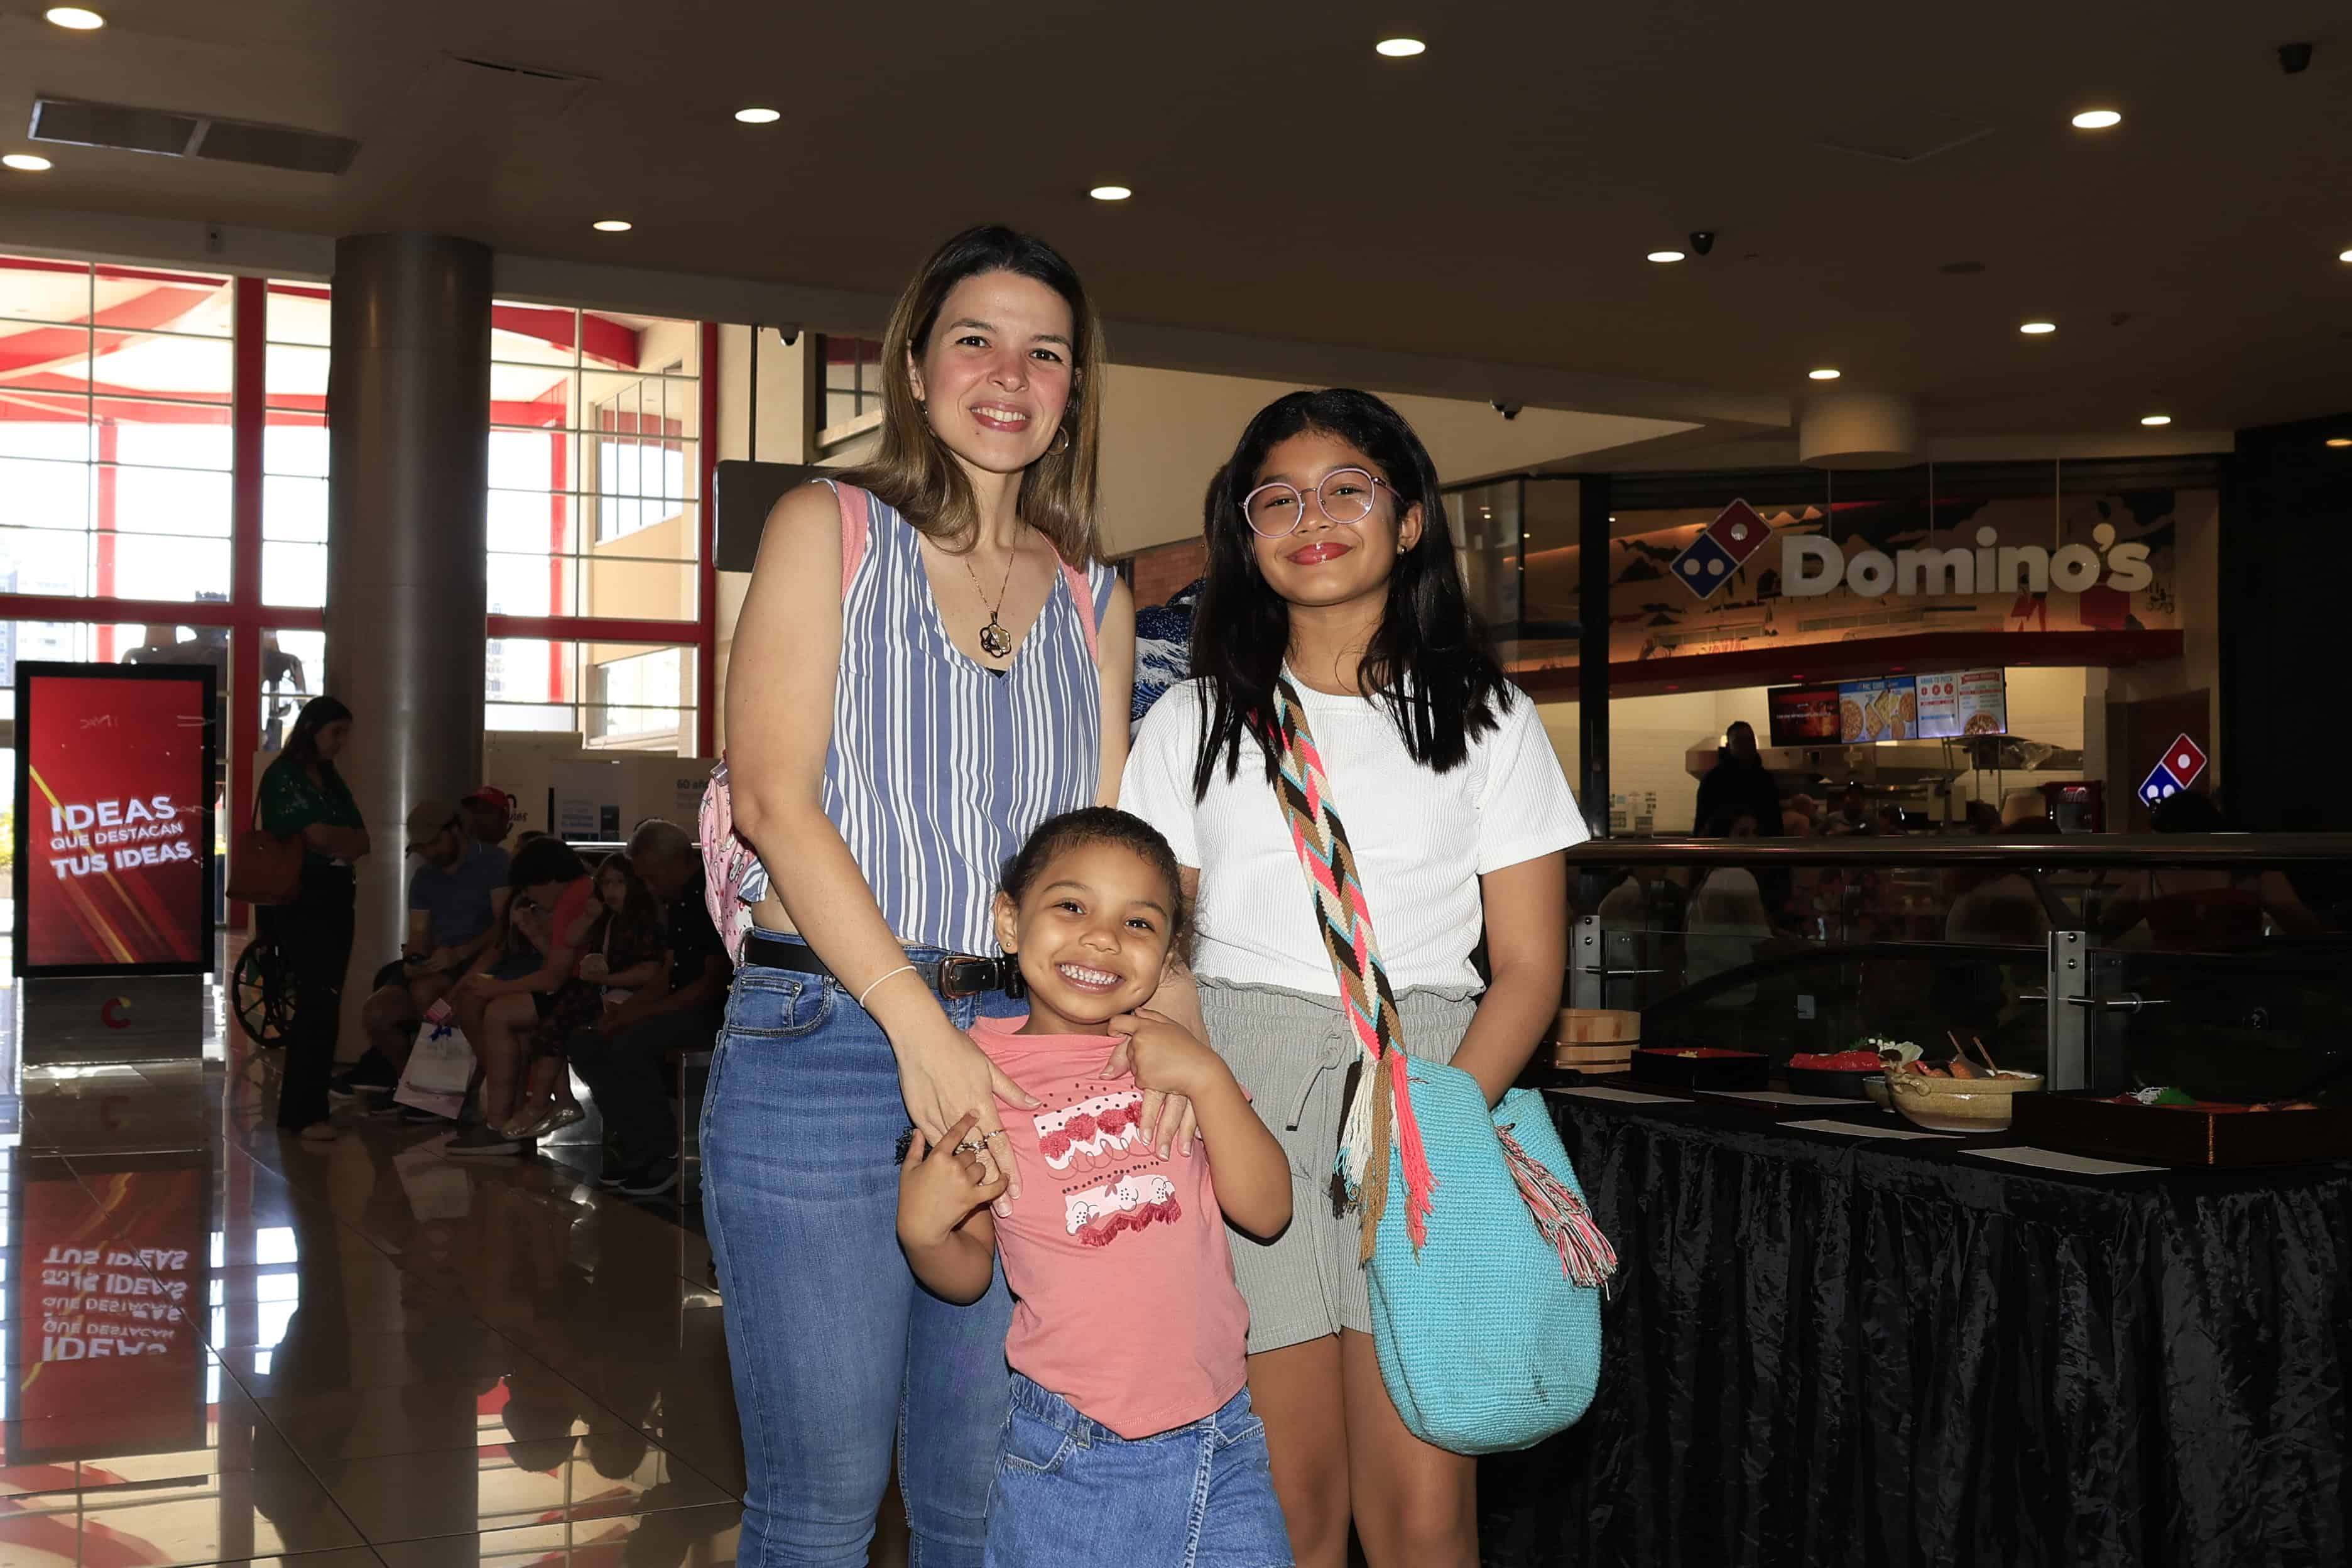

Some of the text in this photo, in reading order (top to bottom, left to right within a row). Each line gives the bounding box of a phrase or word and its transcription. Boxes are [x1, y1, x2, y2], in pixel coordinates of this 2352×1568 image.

[1782, 522, 2153, 597] Domino's
[51, 796, 176, 834] IDEAS
[50, 822, 184, 850] QUE DESTACAN
[50, 841, 192, 880] TUS IDEAS
